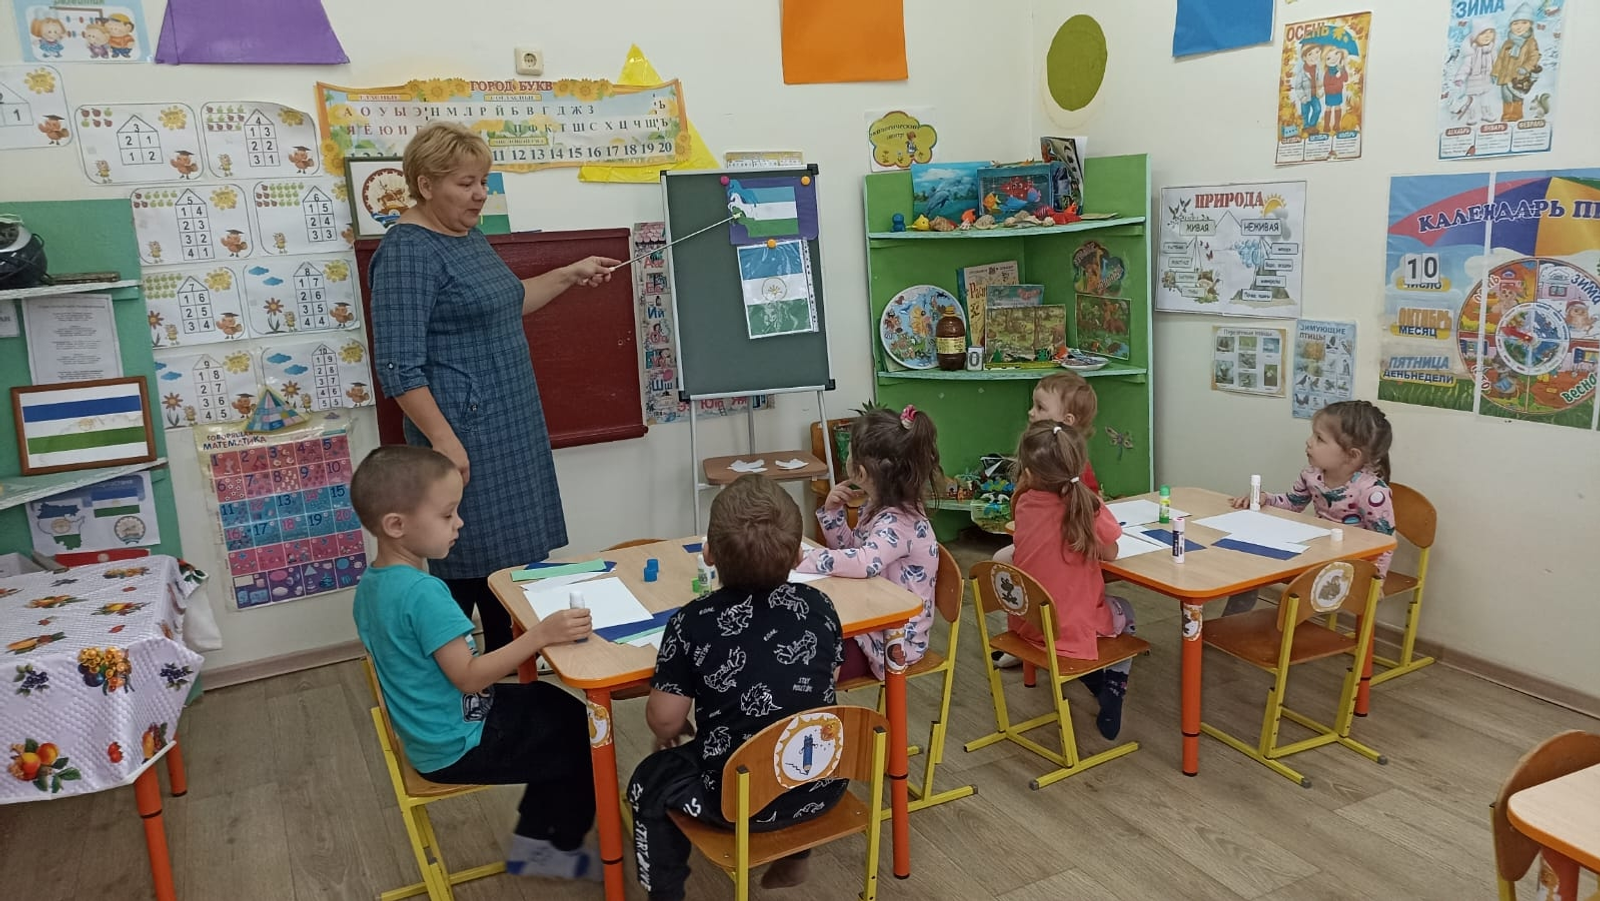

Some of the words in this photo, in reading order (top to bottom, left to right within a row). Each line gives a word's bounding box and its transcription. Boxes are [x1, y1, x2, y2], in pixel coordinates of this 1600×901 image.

[1456, 0, 1505, 18] ЗИМА
[1286, 21, 1330, 42] ОСЕНЬ
[471, 80, 514, 92] ГОРОД
[519, 81, 553, 92] БУКВ
[492, 149, 504, 162] 11
[512, 149, 527, 161] 12
[530, 149, 546, 160] 13
[550, 148, 564, 160] 14
[569, 147, 583, 159] 15
[587, 147, 602, 158] 16
[606, 145, 620, 157] 17
[624, 144, 638, 156] 18
[641, 143, 655, 155] 19
[658, 141, 673, 154] 20
[1195, 192, 1264, 209] ПРИРОДА
[1186, 223, 1209, 232] ЖИВАЯ
[1244, 222, 1279, 232] НЕЖИВАЯ
[1418, 201, 1565, 232] КАЛЕНДАРЬ
[1407, 257, 1438, 280] 10
[1398, 308, 1453, 329] ОКТЯБРЬ
[1399, 325, 1438, 339] МЕСЯЦ
[1389, 356, 1450, 370] ПЯТНИЦА
[652, 380, 673, 391] Шш
[203, 435, 267, 450] МАТЕМАТИКА
[213, 454, 219, 466] 1
[241, 450, 249, 462] 2
[269, 446, 278, 459] 3
[297, 442, 306, 454] 4
[323, 438, 332, 451] 5
[217, 478, 226, 491] 6
[245, 474, 254, 487] 7
[273, 471, 283, 483] 8
[301, 466, 310, 479] 9
[327, 462, 341, 474] 10
[221, 503, 234, 516] 11
[250, 499, 264, 511] 12
[278, 495, 292, 507] 13
[305, 490, 319, 502] 14
[331, 486, 346, 498] 15
[226, 528, 241, 541] 16
[254, 522, 268, 536] 17
[281, 518, 295, 531] 18
[308, 513, 323, 527] 19
[336, 509, 351, 522] 20
